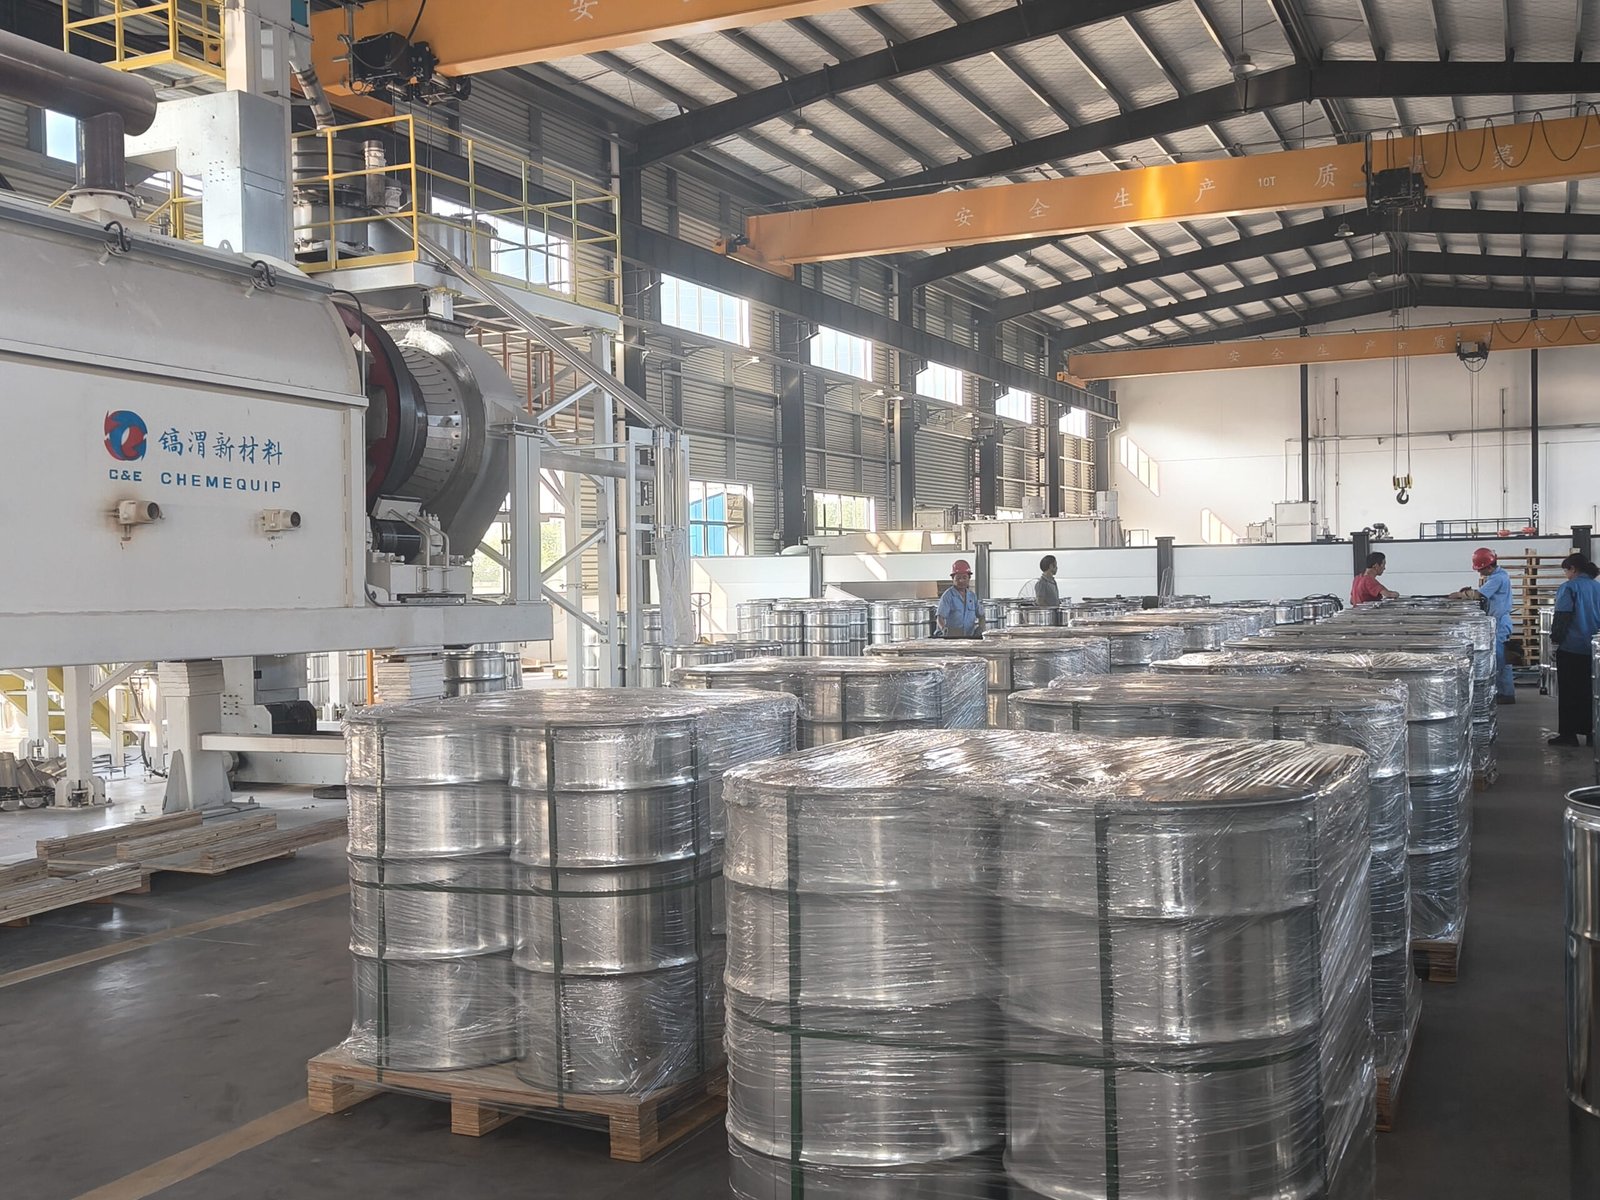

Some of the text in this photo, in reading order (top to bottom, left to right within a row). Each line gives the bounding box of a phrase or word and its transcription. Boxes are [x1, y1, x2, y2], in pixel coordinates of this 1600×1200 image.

[954, 178, 1216, 227] 安全生产
[1258, 176, 1276, 188] 10T
[158, 428, 283, 465] 镐渭新材料
[109, 469, 281, 492] C&E CHEMEQUIP
